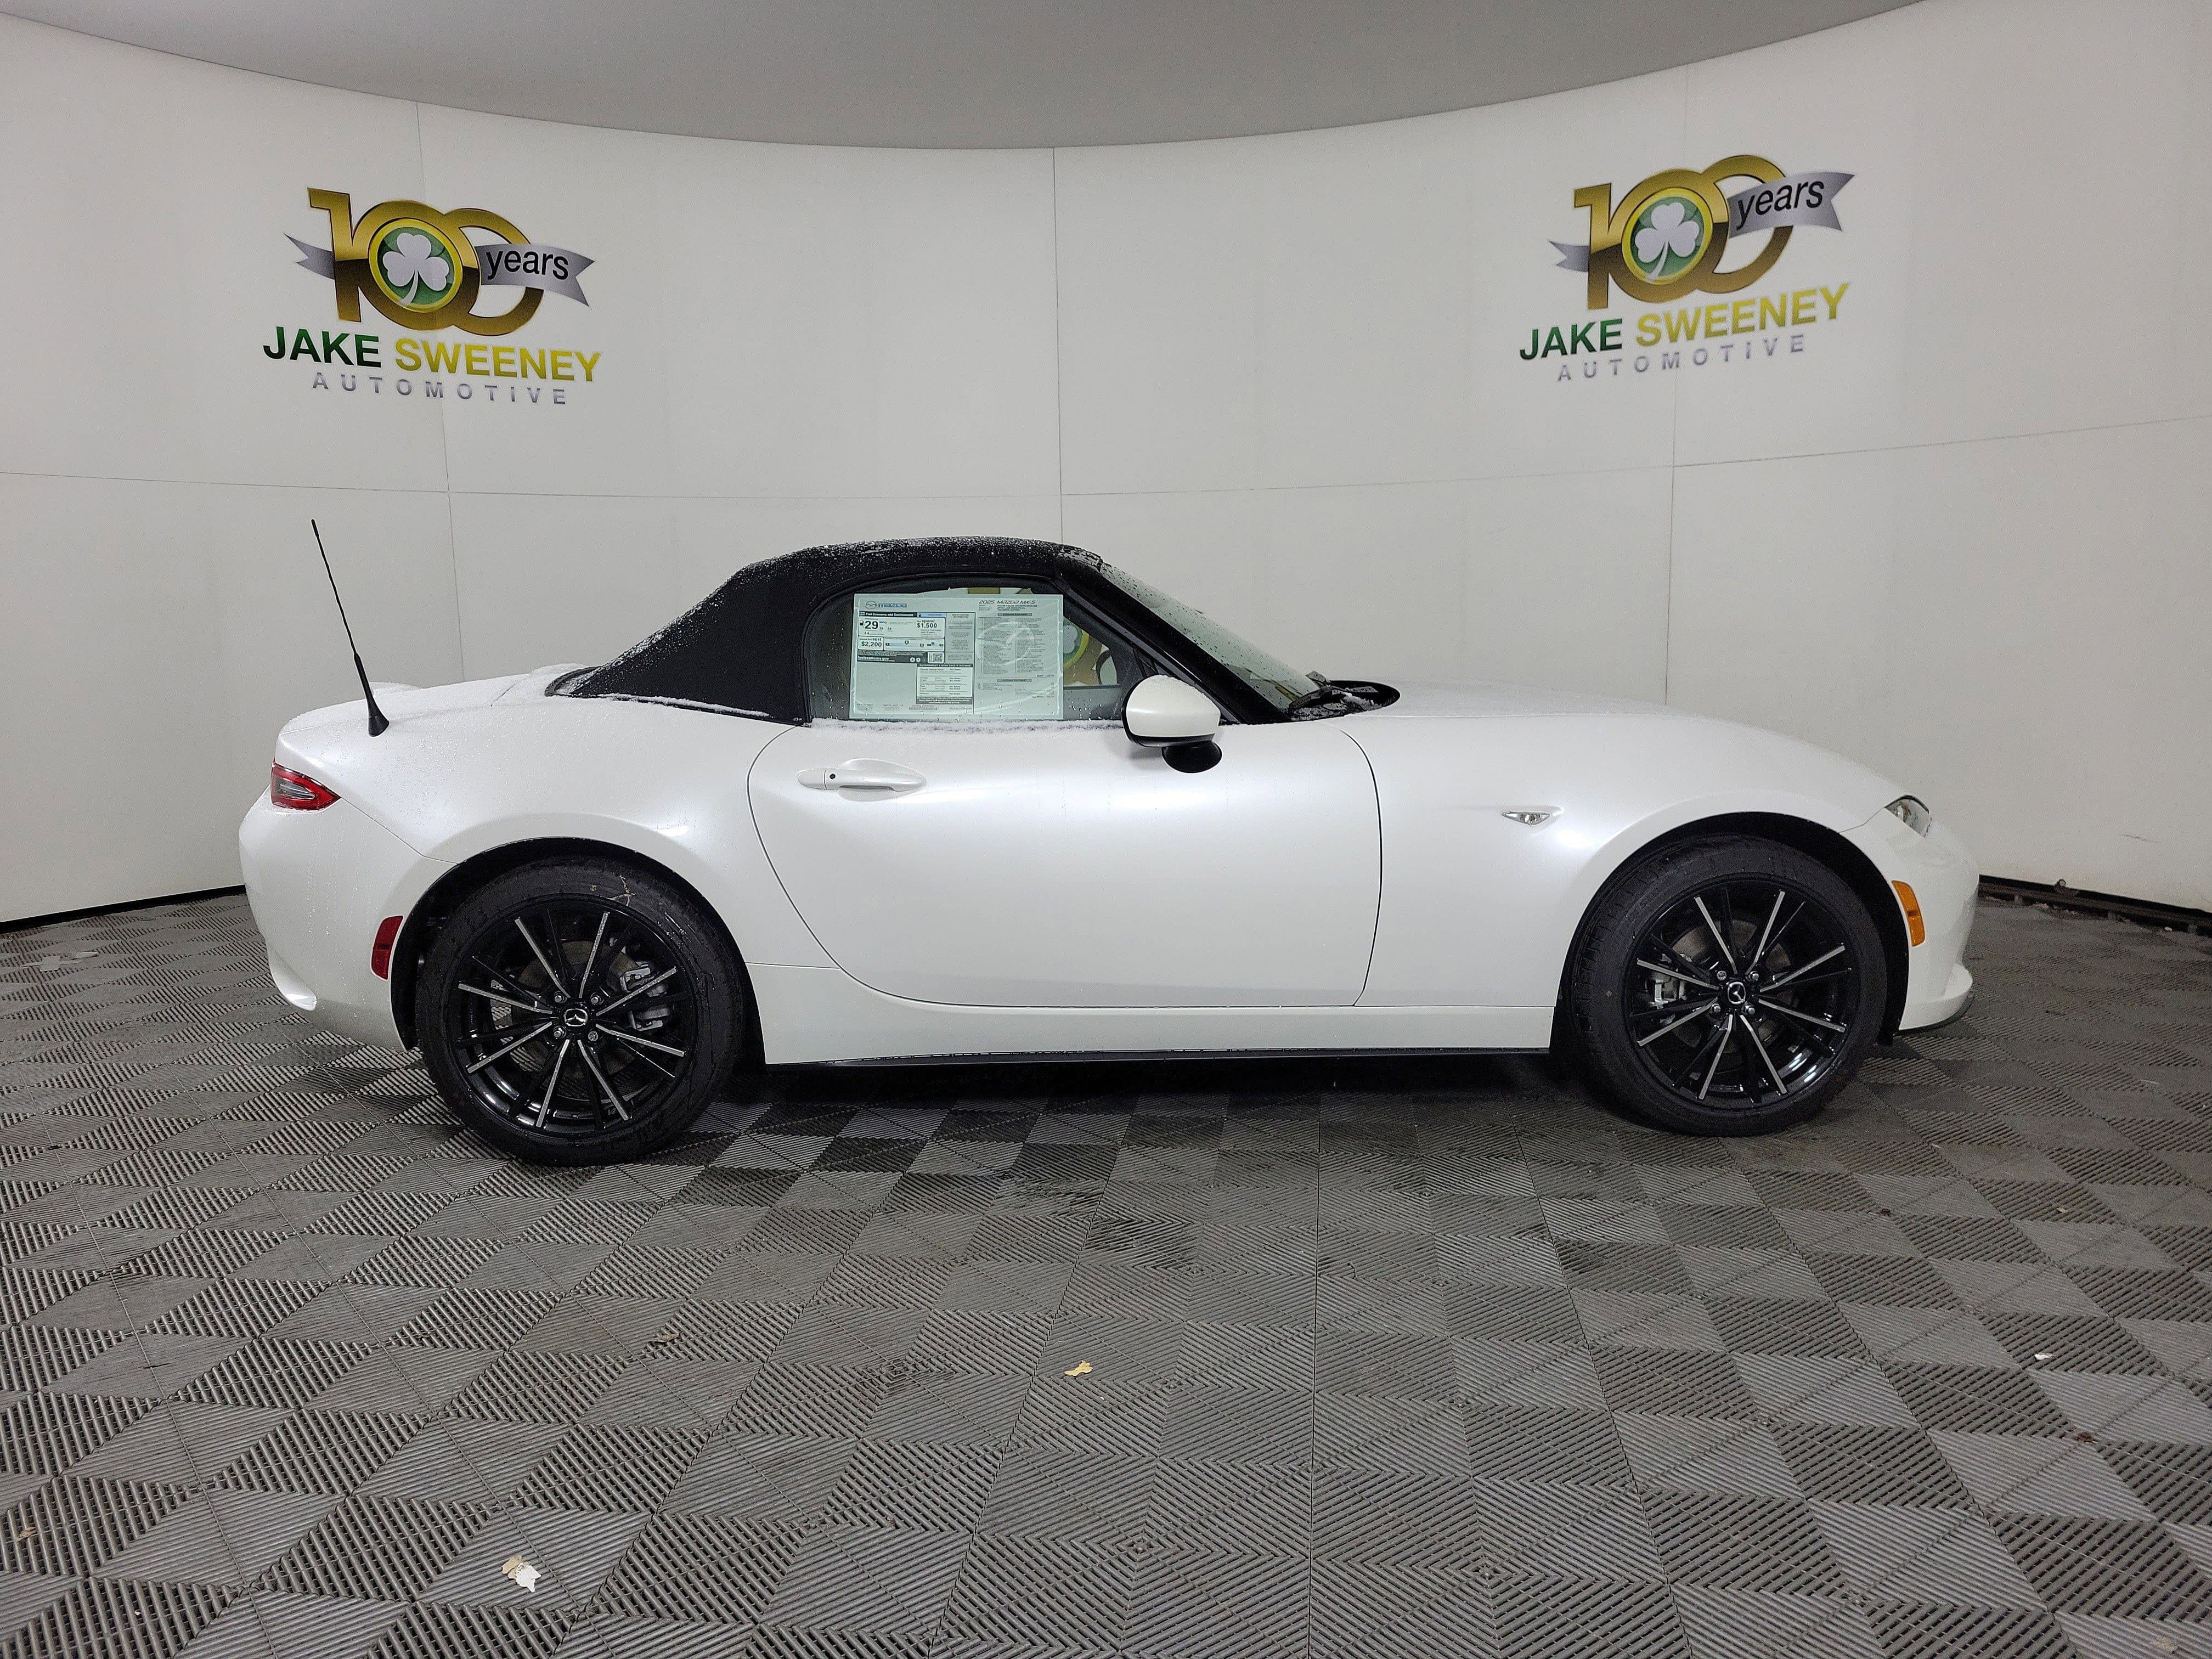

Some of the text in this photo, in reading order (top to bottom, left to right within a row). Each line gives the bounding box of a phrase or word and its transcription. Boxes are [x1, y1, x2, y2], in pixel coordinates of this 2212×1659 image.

[1737, 180, 1825, 230] years
[1573, 154, 1794, 310] 100
[307, 187, 545, 336] 100
[486, 247, 569, 280] years
[1519, 284, 1850, 360] JAKE SWEENEY
[263, 326, 601, 382] JAKE SWEENEY
[1558, 334, 1804, 382] AUTOMOTIVE
[312, 372, 566, 405] AUTOMOTIVE
[865, 620, 878, 629] 29
